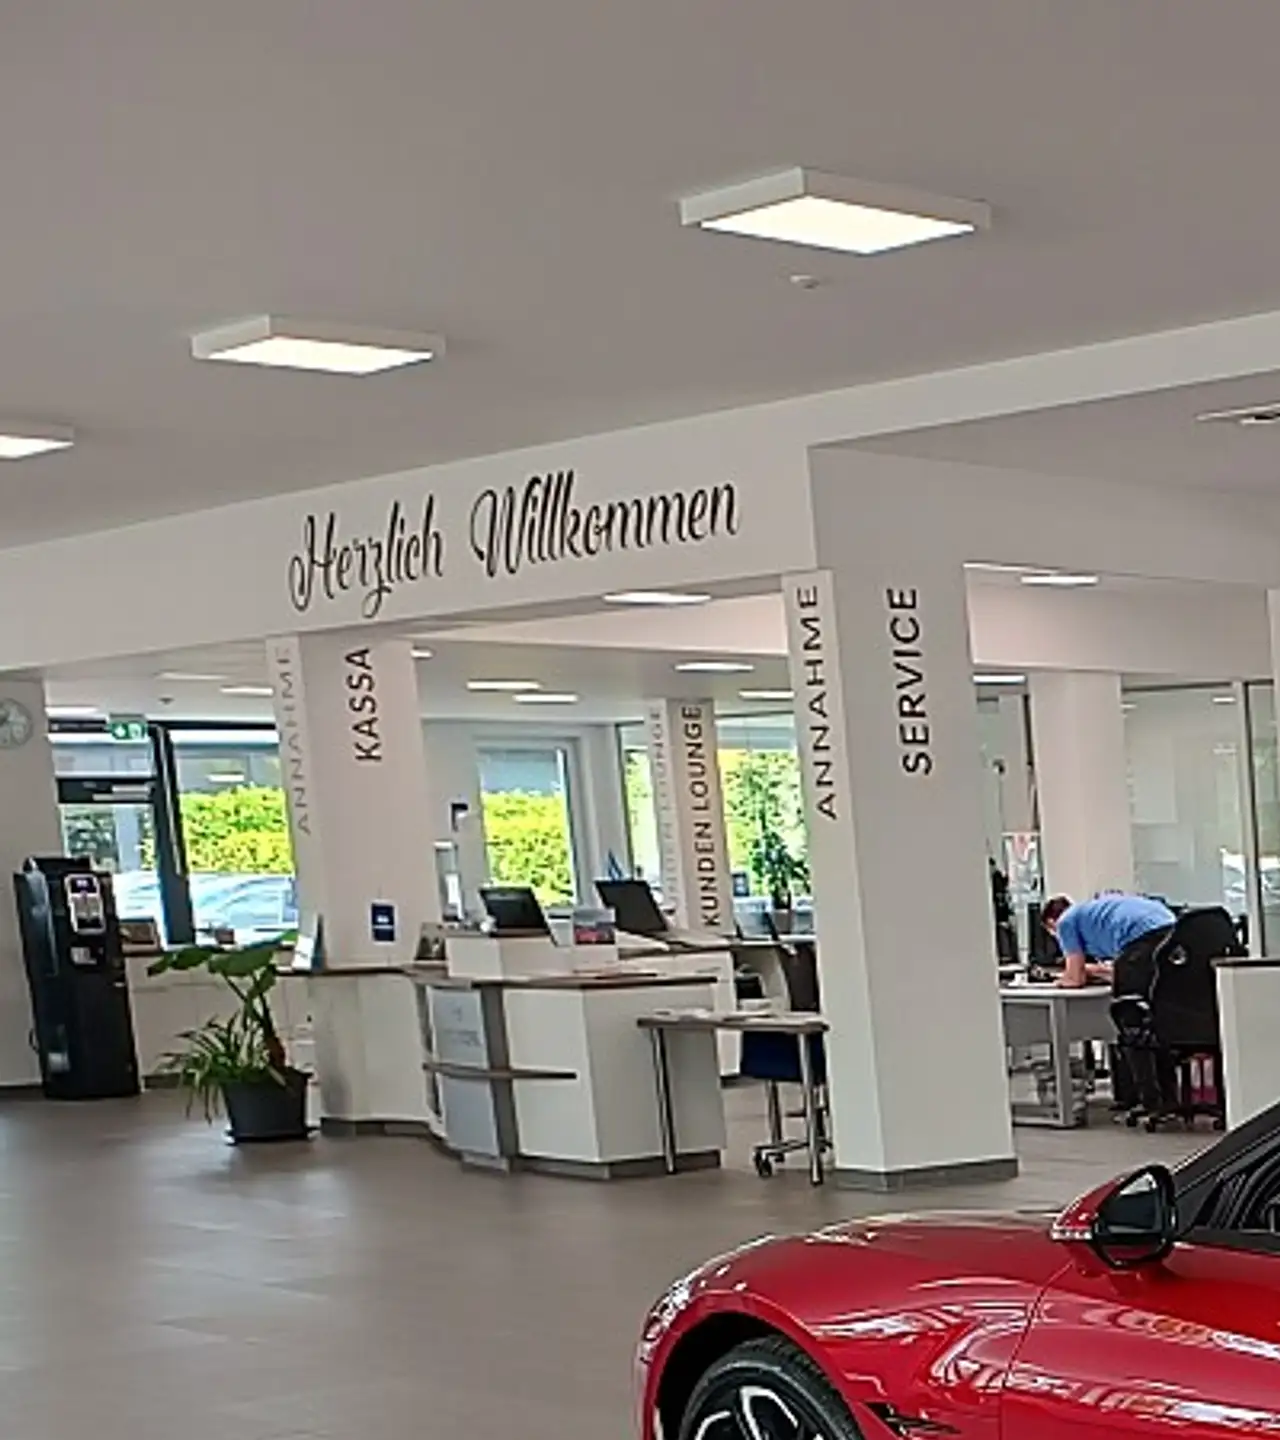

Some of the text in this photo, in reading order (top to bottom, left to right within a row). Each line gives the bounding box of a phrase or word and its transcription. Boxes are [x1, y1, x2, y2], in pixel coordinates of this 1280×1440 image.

[289, 470, 738, 618] Herzlich Willkommen
[345, 648, 382, 761] KASSA
[797, 585, 837, 819] ANNAHME
[886, 587, 933, 775] SERVICE
[681, 705, 721, 927] KUNDEN LOUNGE
